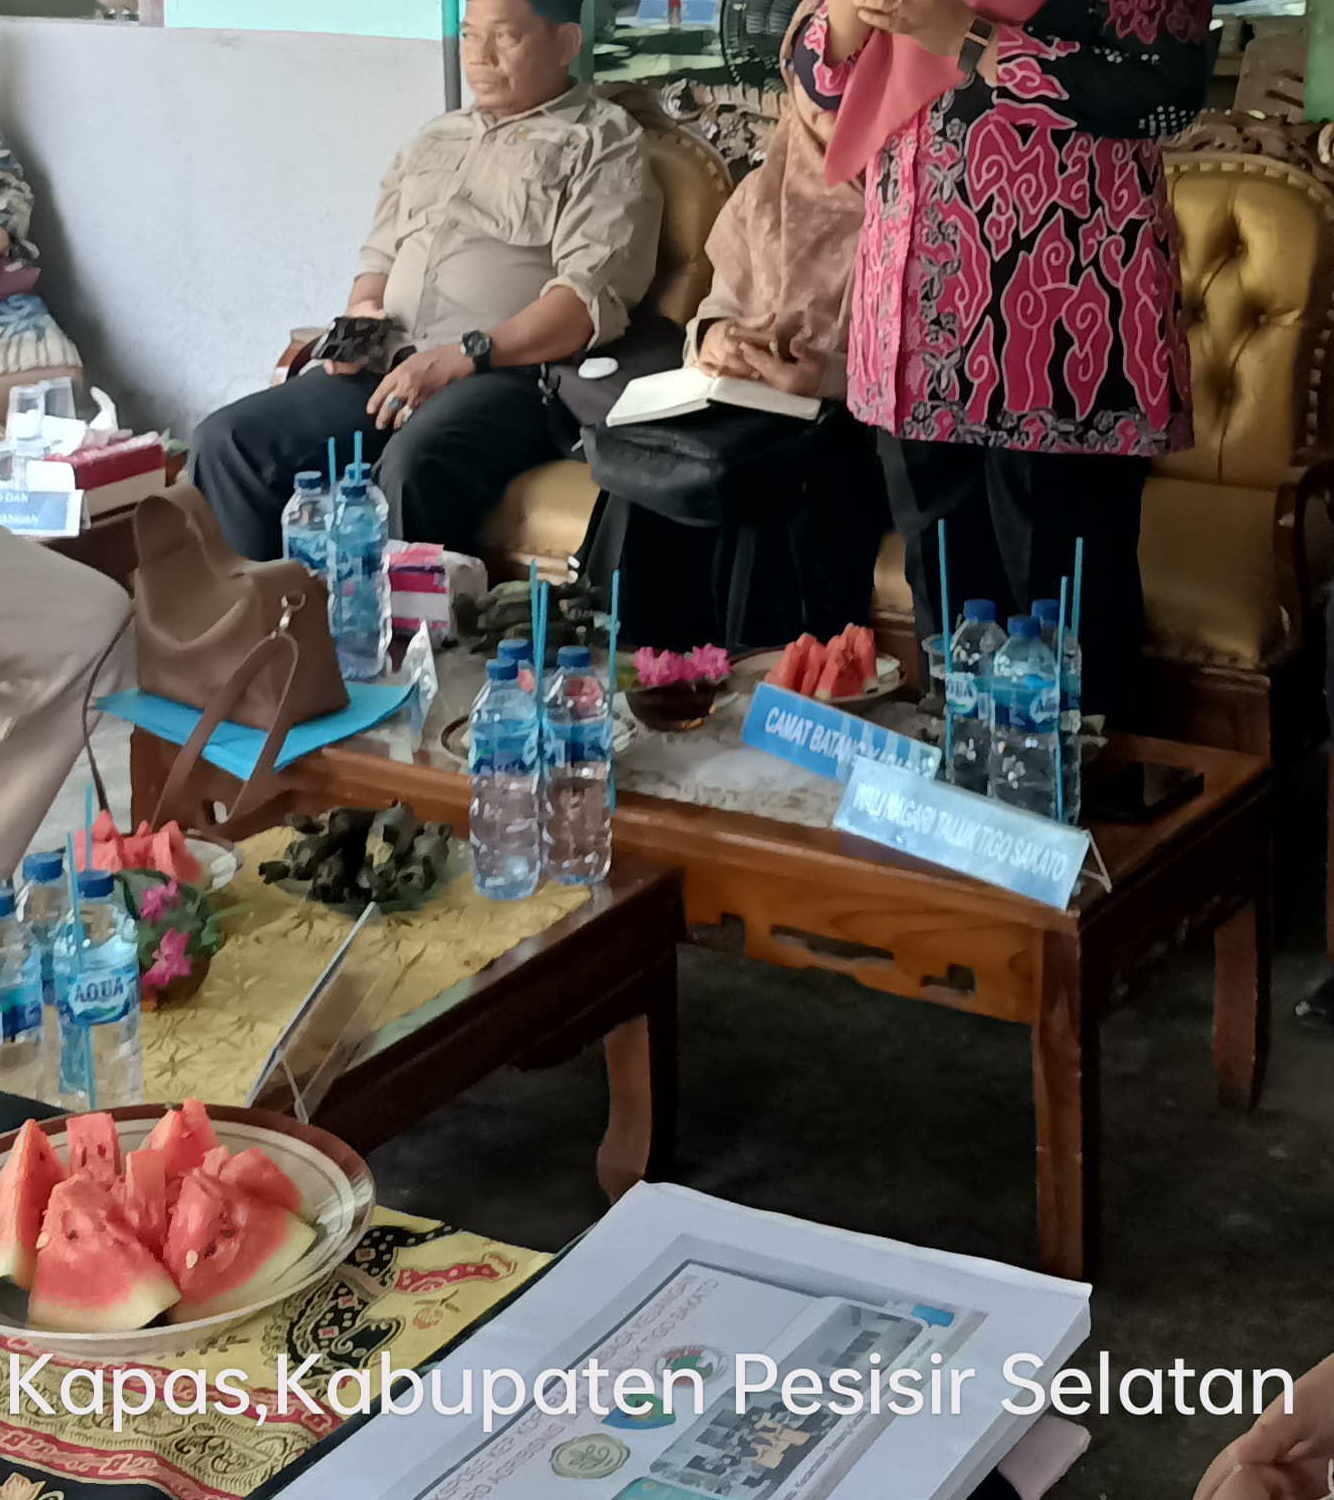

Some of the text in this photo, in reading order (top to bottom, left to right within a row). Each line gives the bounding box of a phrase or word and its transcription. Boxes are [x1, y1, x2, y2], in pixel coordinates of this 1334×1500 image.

[765, 707, 812, 746] CAMAT
[885, 792, 935, 834] NAGARI
[935, 808, 980, 851] TALUK
[979, 823, 1012, 861] TIGO
[1010, 838, 1068, 880] SAKATO
[75, 977, 124, 1002] AQUA
